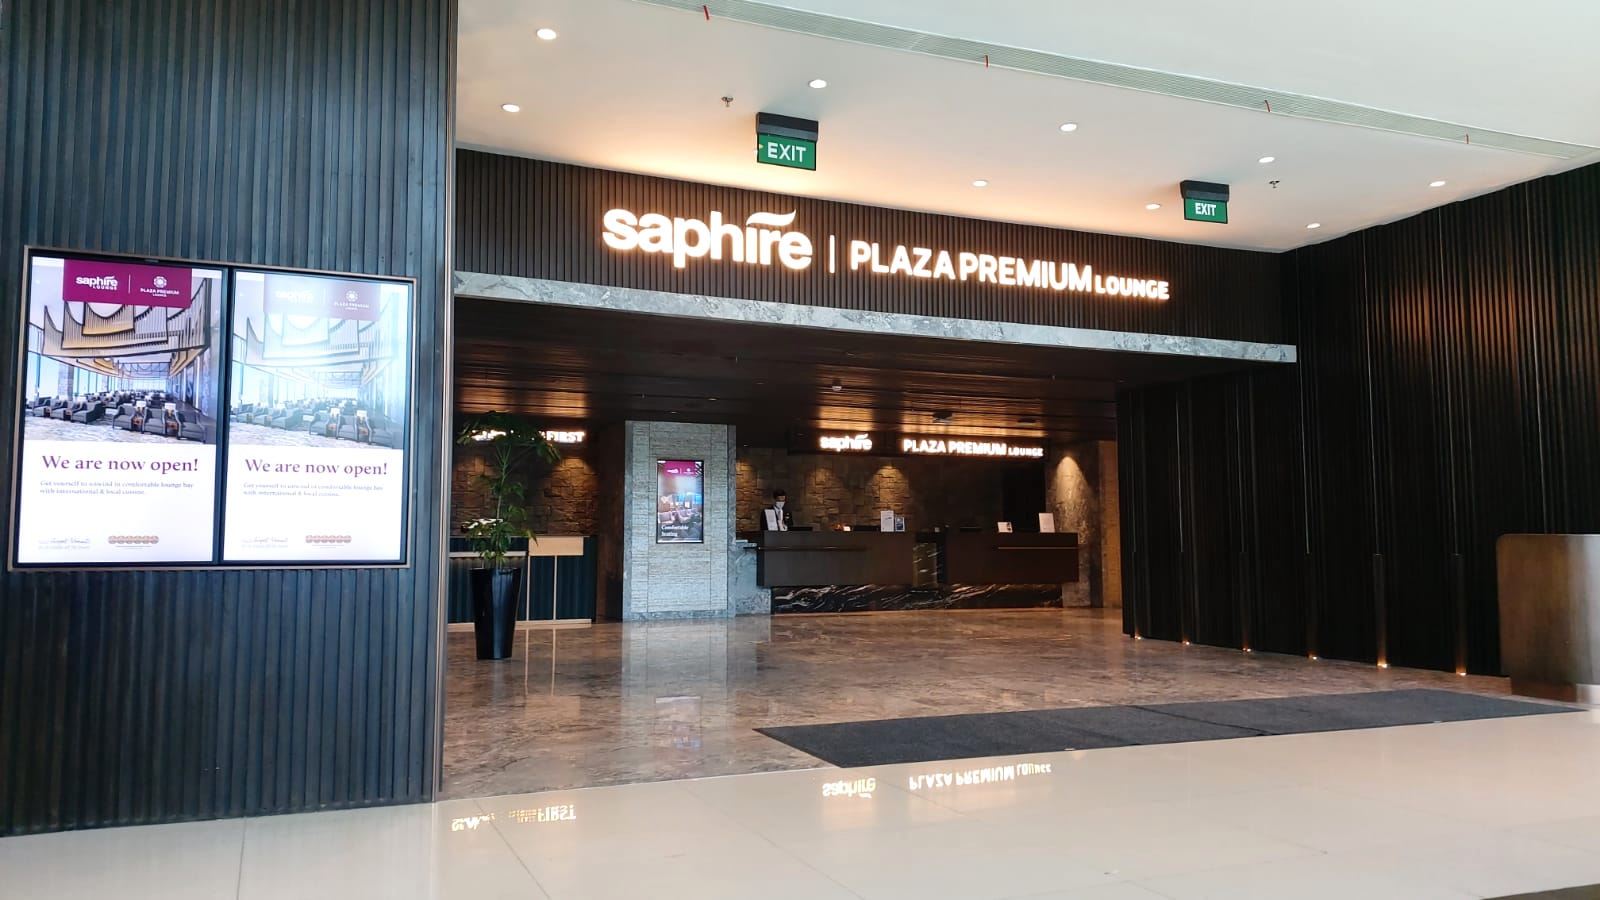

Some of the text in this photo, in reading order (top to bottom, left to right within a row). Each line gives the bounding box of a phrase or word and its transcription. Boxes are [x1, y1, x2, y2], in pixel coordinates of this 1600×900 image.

[767, 141, 807, 163] EXIT
[1194, 202, 1217, 216] EXIT
[602, 208, 813, 270] saphire
[850, 240, 1170, 299] PLAZA PREMIUM LOUNGE
[75, 275, 118, 287] saphire
[546, 430, 585, 443] FIRST
[820, 433, 873, 452] saphire
[903, 438, 1044, 457] PLAZA PREMIUM LOUNGE
[42, 455, 198, 475] We are now open!
[245, 458, 388, 478] We are now open!
